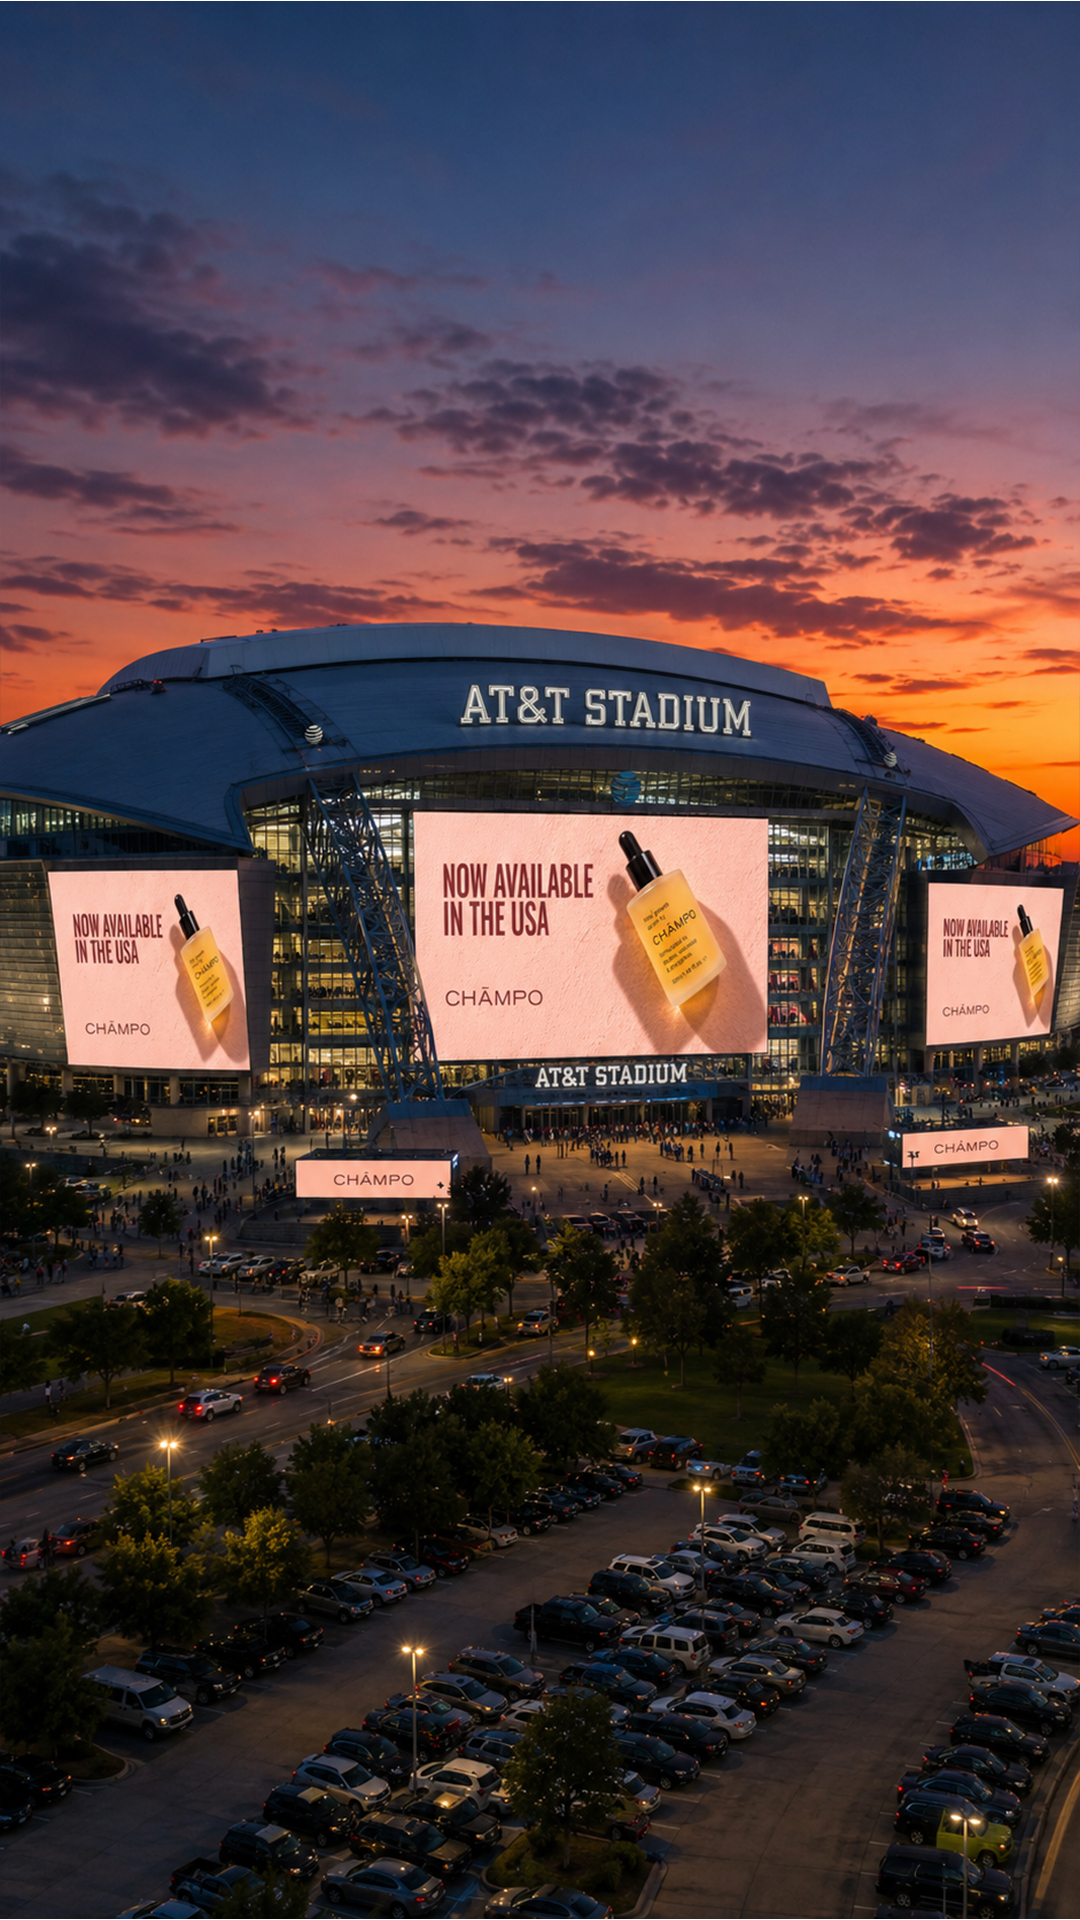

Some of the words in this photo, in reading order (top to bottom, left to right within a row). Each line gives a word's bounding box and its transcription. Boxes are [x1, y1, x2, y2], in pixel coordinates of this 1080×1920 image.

[460, 685, 570, 724] AT&T
[585, 689, 751, 737] STADIUM
[443, 863, 487, 898] NOW
[493, 863, 594, 898] AVAILABLE
[72, 914, 100, 938] NOW
[103, 914, 163, 938] AVAILABLE
[444, 901, 463, 936] IN
[469, 901, 505, 936] THE
[511, 901, 549, 936] USA
[943, 918, 965, 937] NOW
[966, 919, 1009, 938] AVAILABLE
[75, 940, 88, 964] IN
[90, 940, 113, 964] THE
[115, 940, 139, 964] USA
[943, 939, 953, 957] IN
[955, 939, 972, 957] THE
[973, 939, 990, 957] USA
[445, 986, 543, 1006] CHĀMPO
[85, 1021, 151, 1036] CHĀMPO
[535, 1066, 588, 1088] AT&T
[595, 1063, 687, 1086] STADIUM
[333, 1171, 414, 1186] CHĀMPO
